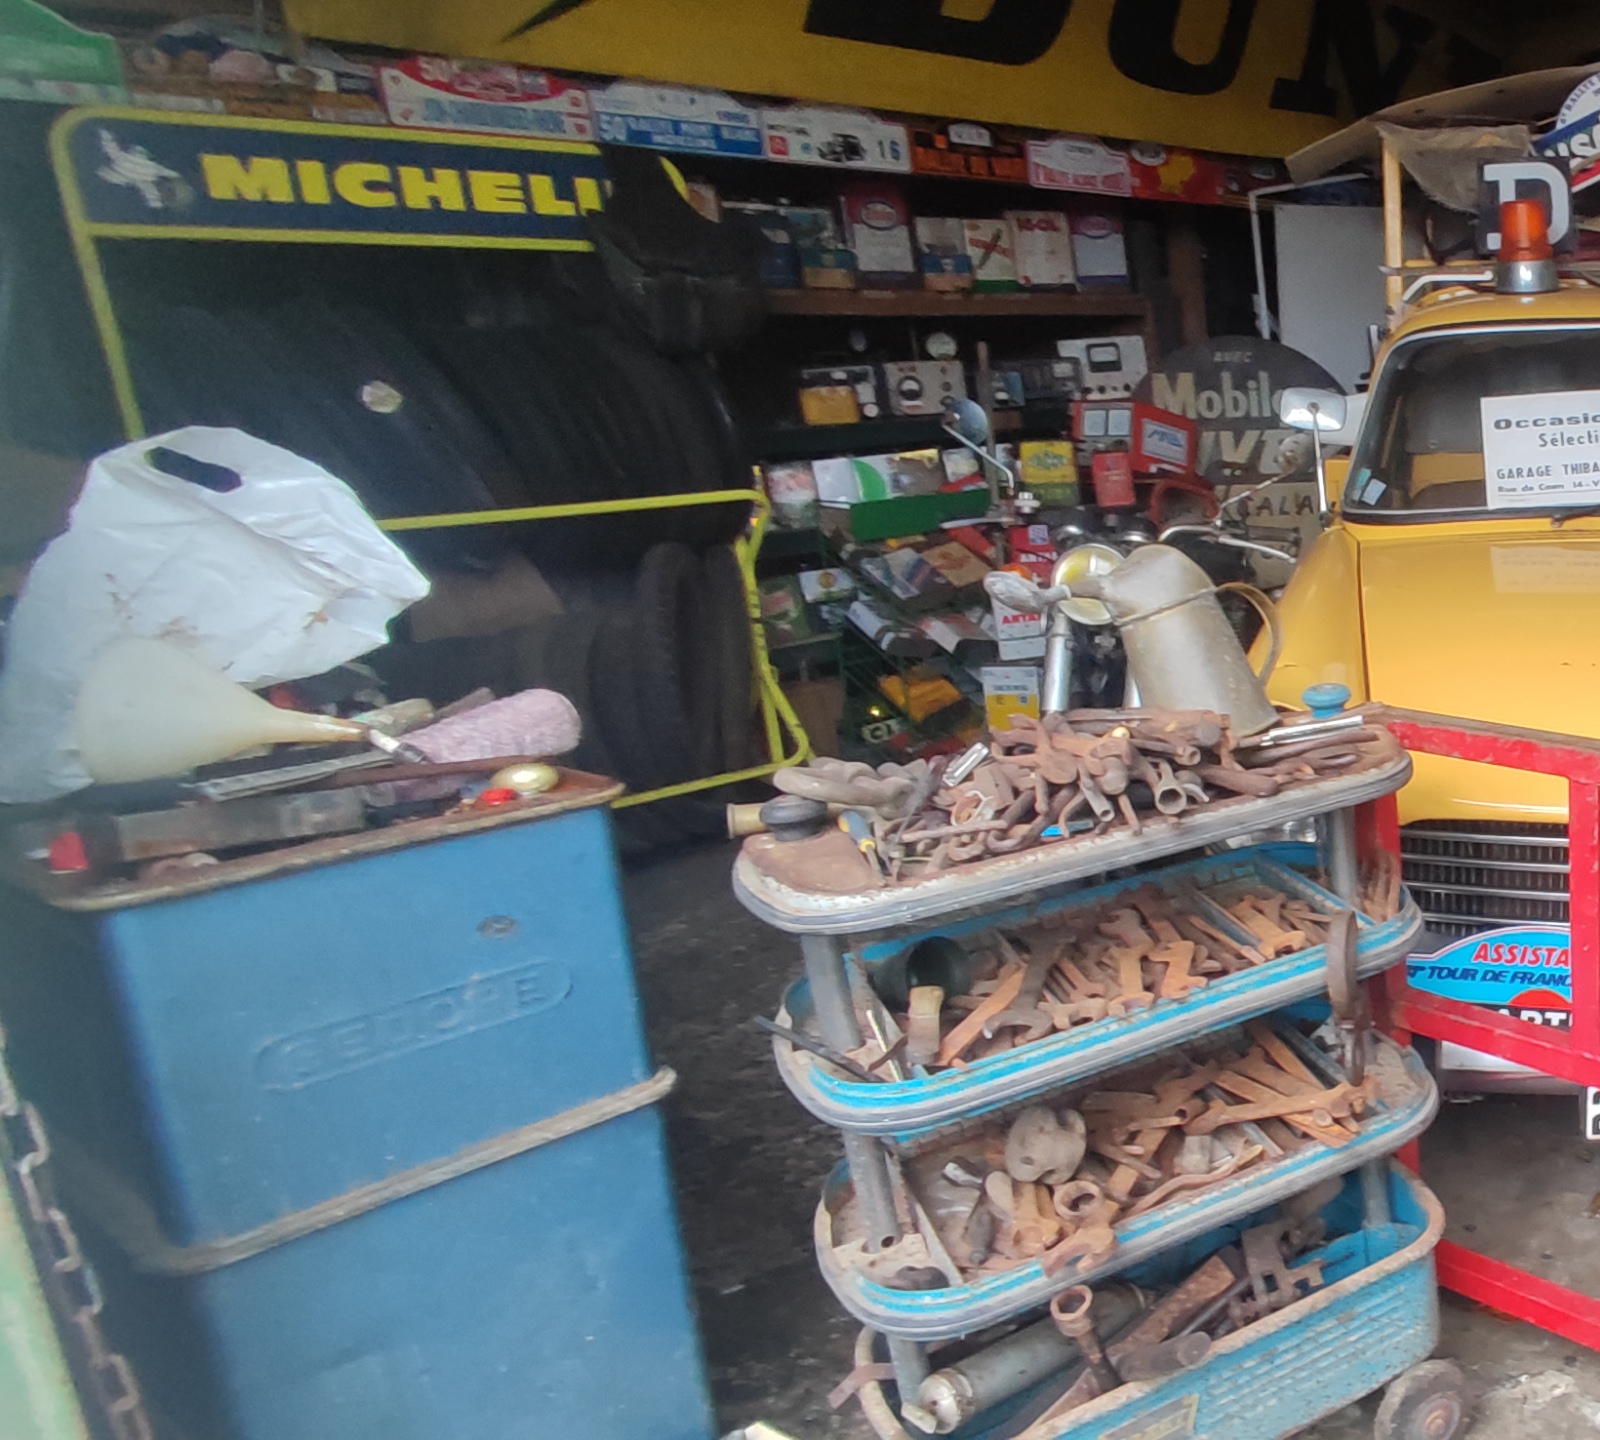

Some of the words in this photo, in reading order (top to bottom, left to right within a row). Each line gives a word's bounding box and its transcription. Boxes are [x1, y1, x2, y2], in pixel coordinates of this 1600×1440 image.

[1152, 370, 1290, 419] Mobil
[1496, 464, 1553, 480] GARAGE
[1427, 966, 1478, 981] TOUR
[1480, 969, 1509, 984] DE
[1509, 971, 1573, 988] FRANC
